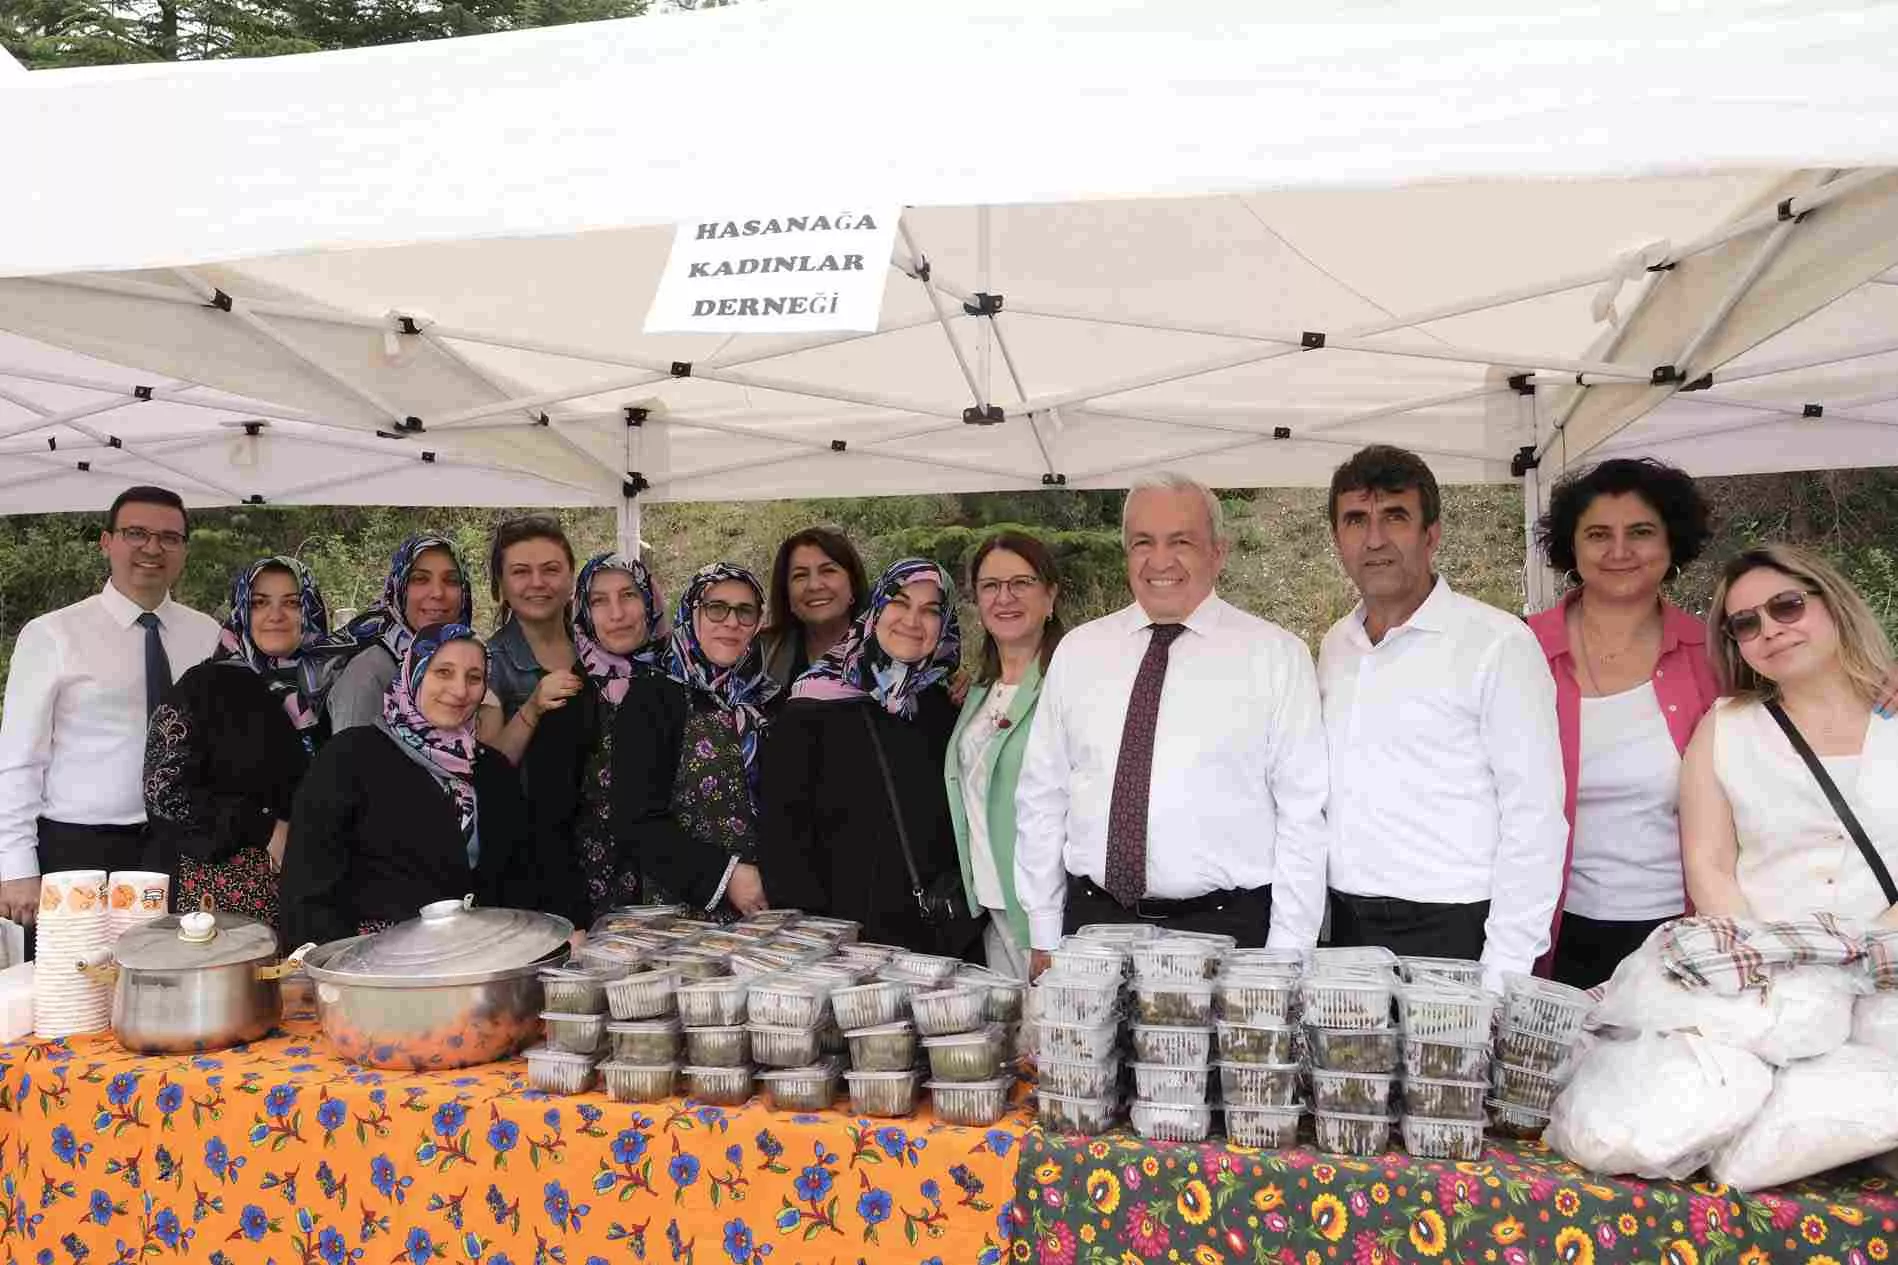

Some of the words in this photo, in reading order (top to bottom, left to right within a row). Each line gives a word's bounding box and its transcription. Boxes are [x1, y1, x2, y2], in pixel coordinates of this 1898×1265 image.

[695, 211, 877, 240] HASANAĞA
[688, 254, 864, 278] KADINLAR
[691, 292, 839, 317] DERNEĞİ
